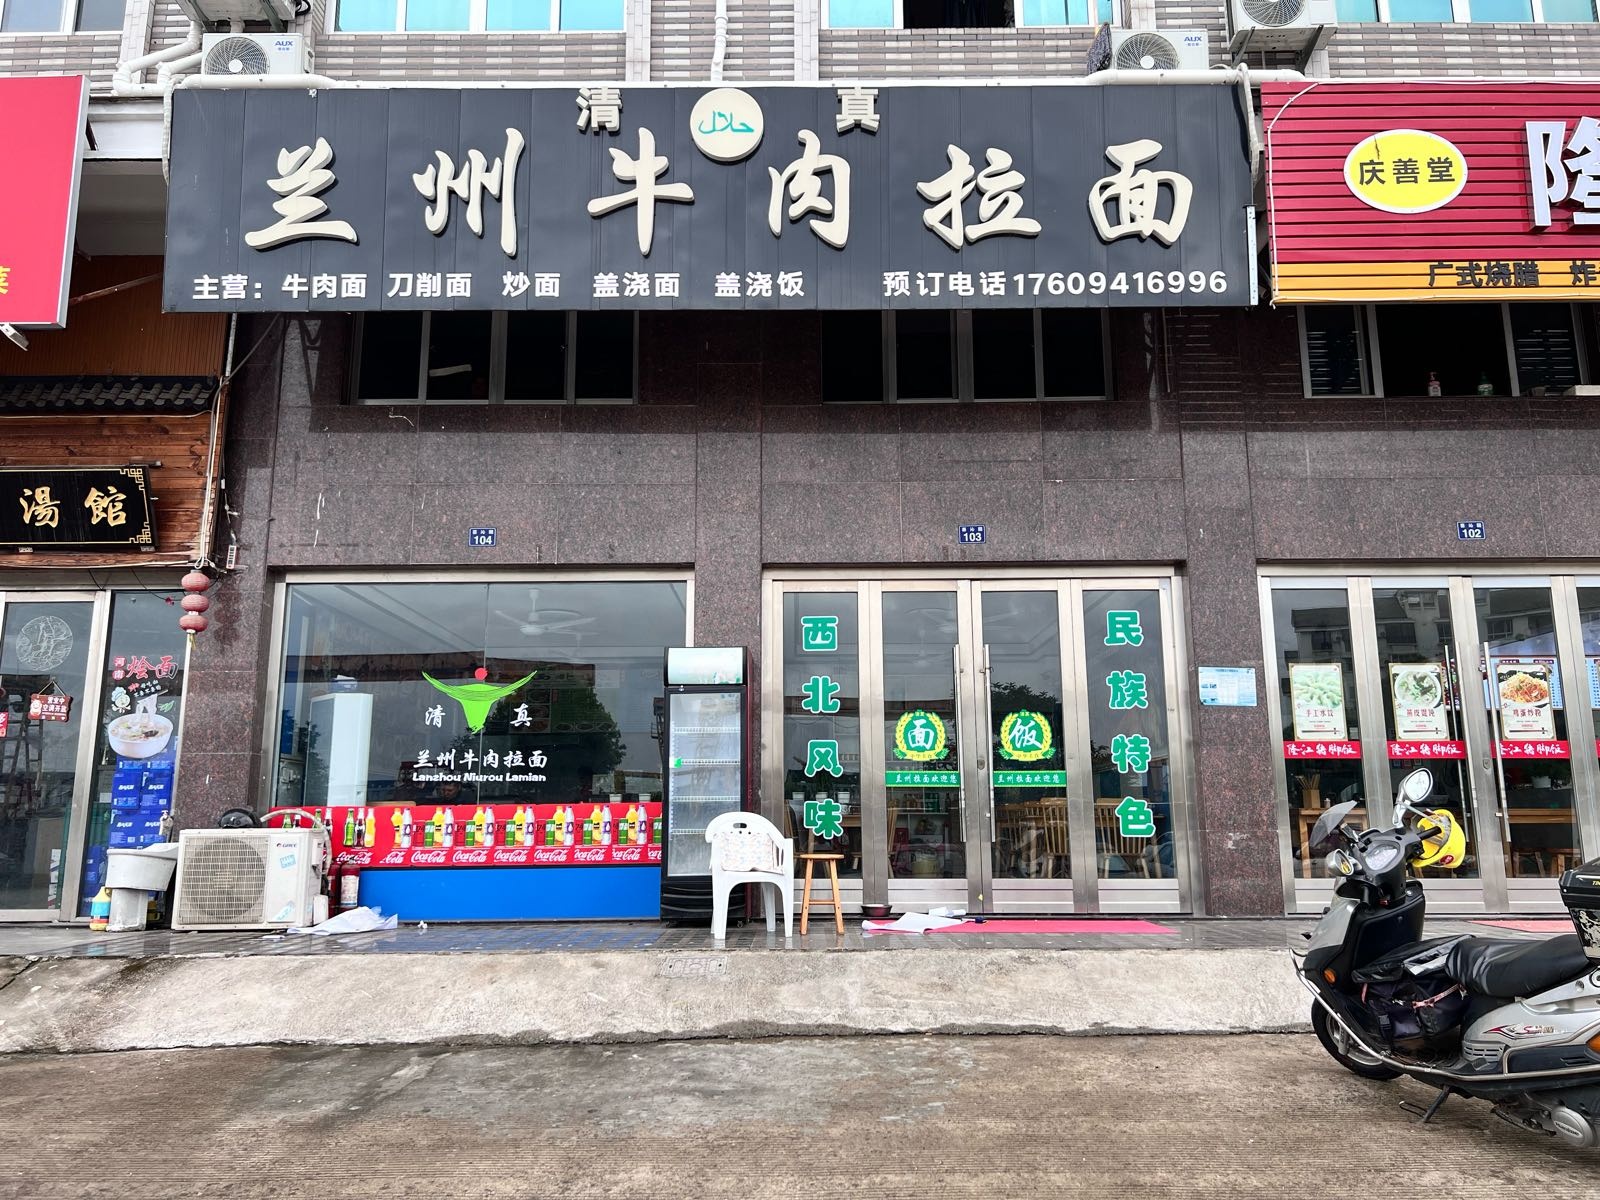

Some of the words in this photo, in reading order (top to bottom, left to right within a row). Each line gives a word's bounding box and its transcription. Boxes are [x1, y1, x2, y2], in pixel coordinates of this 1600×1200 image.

[576, 86, 623, 132] 清
[836, 86, 880, 133] 真
[698, 110, 754, 135] حلال
[1359, 157, 1455, 186] 庆善堂
[244, 127, 1194, 257] 兰州牛肉拉面
[281, 272, 367, 299] 牛肉面
[387, 271, 472, 298] 刀削面
[502, 271, 561, 298] 炒面
[593, 271, 680, 298] 盖浇面
[714, 270, 805, 298] 盖浇饭
[1429, 261, 1540, 288] 广式烧腊
[19, 486, 127, 528] 湯館
[473, 535, 493, 545] 104
[963, 532, 982, 542] 103
[1462, 529, 1482, 538] 102
[126, 654, 179, 680] 烩面
[424, 704, 446, 728] 清
[510, 702, 533, 727] 真
[801, 615, 844, 840] 西北风味
[1104, 610, 1157, 838] 民族特色
[907, 718, 935, 750] 面
[1008, 717, 1043, 749] 饭
[413, 748, 548, 770] 兰州牛肉拉面
[1286, 743, 1358, 756] 隆江猪脚饭
[1390, 743, 1462, 756] 隆江猪脚饭
[412, 772, 461, 782] Lanzhou
[463, 772, 503, 782] Niurou
[505, 772, 547, 782] Lamian
[895, 773, 958, 784] 兰州拉面欢迎您
[997, 773, 1060, 784] 兰州拉面欢迎您
